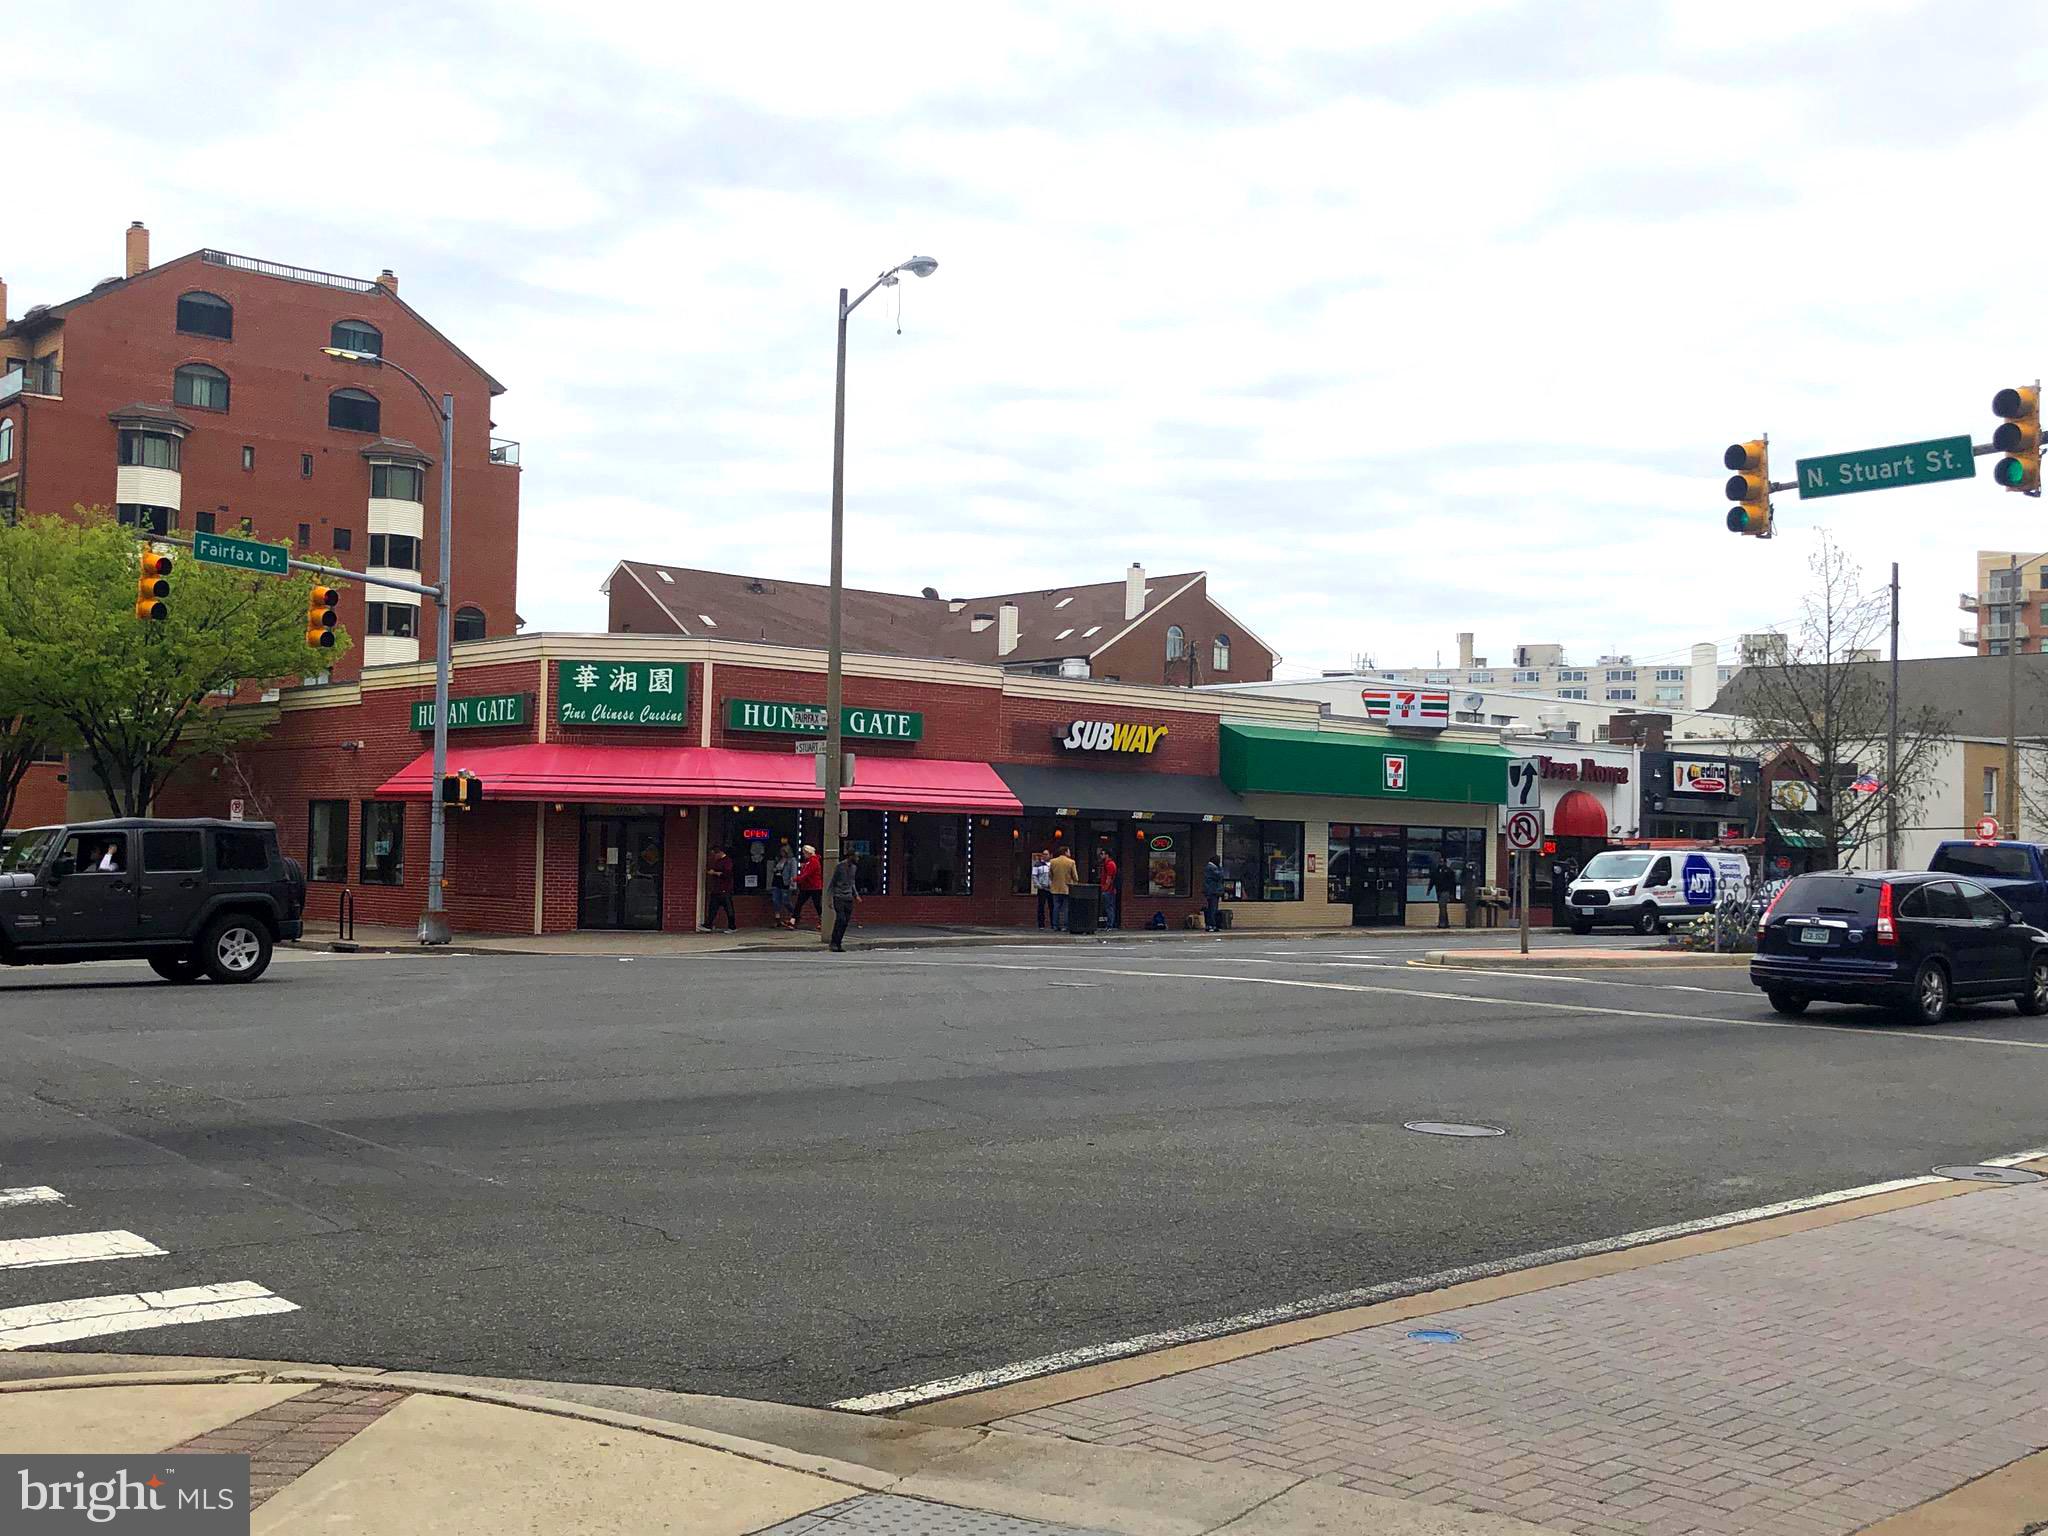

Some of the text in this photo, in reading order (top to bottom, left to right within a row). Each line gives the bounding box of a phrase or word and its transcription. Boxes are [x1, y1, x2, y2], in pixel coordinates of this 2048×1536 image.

[1807, 449, 1962, 488] N. Stuart St.
[200, 540, 281, 567] Fairfax Dr.
[572, 664, 674, 694] 華湘園
[418, 698, 516, 726] HUAN GATE
[561, 702, 683, 722] Fine Chinese Cuisine
[795, 713, 820, 724] FAIRFAX
[850, 711, 911, 737] GATE
[1063, 720, 1169, 754] SUBWAY
[743, 829, 768, 838] OPEN
[1688, 873, 1711, 894] ADT
